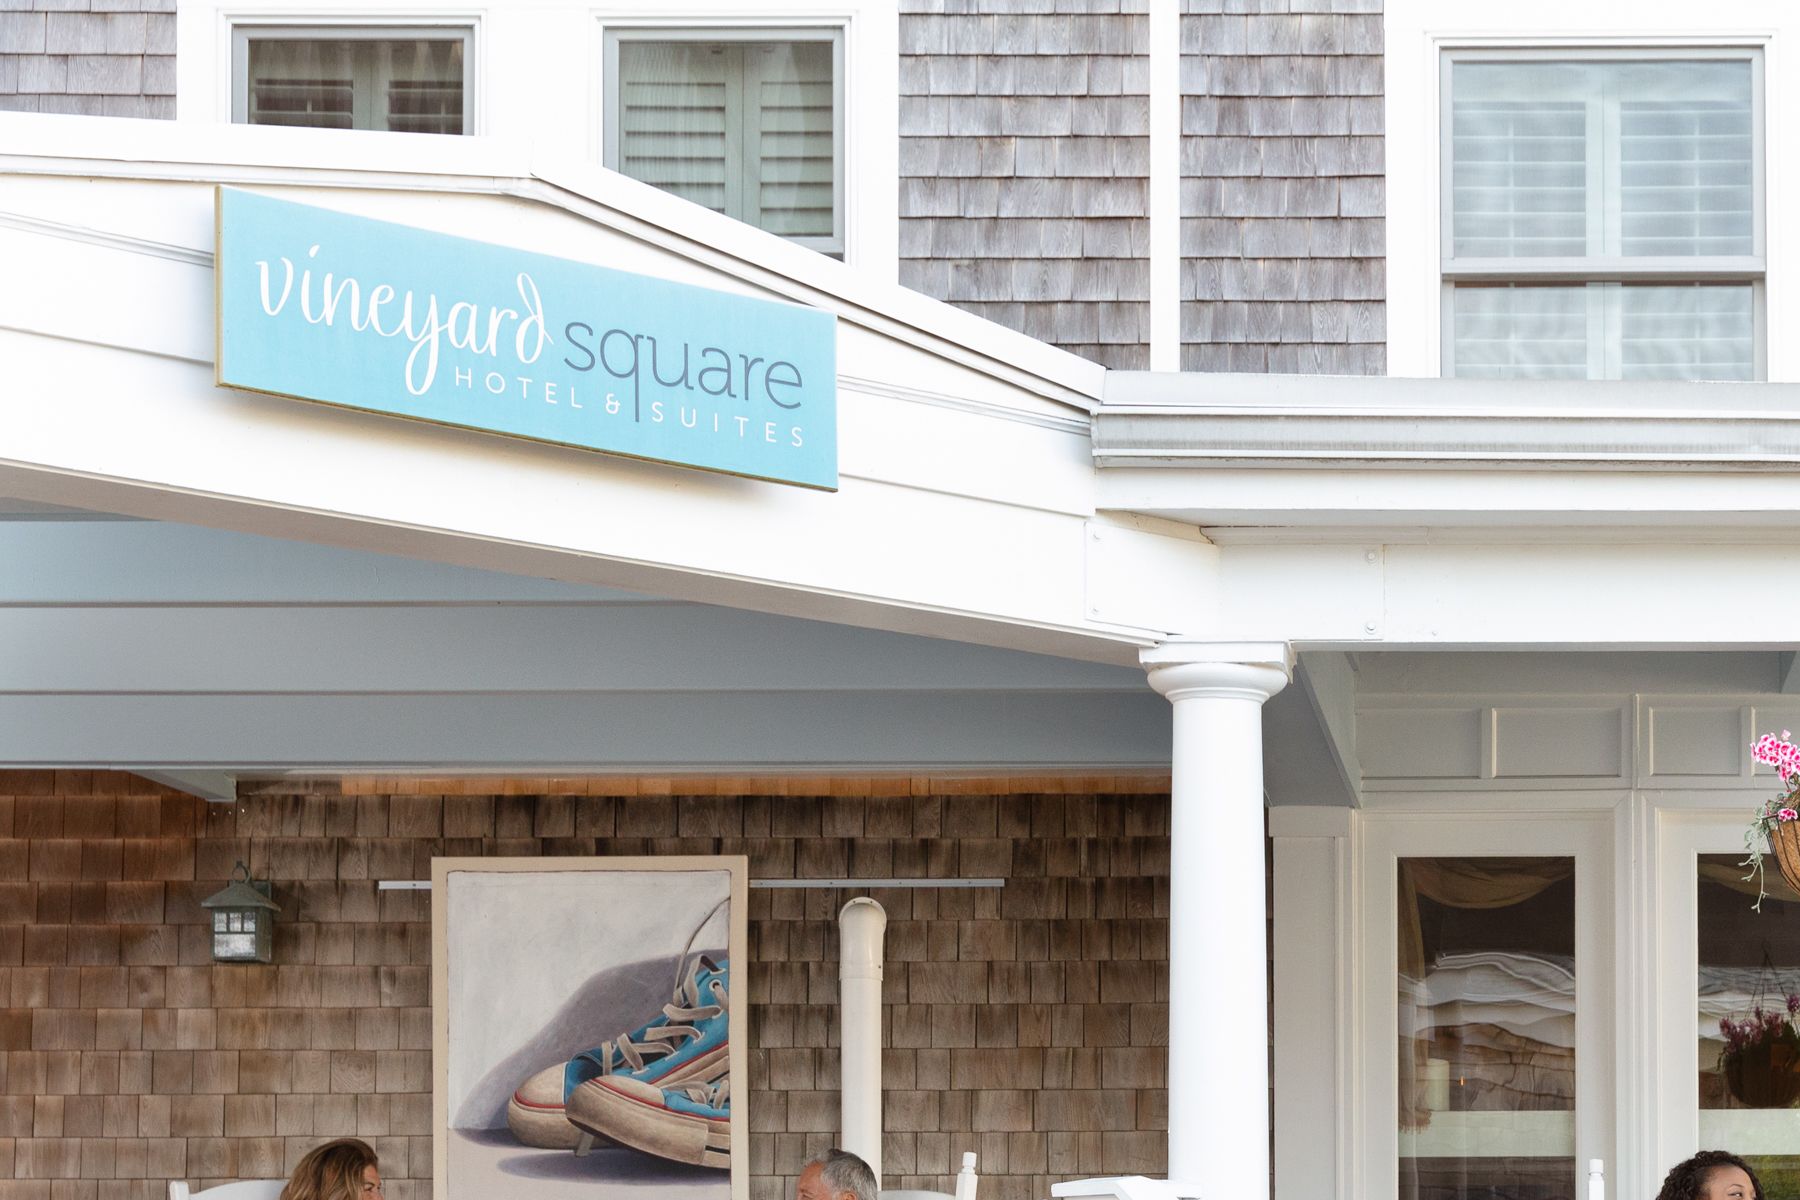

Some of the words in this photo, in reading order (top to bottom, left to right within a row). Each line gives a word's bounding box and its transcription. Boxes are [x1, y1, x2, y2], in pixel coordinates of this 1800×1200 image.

[256, 245, 554, 395] vineyard
[564, 322, 803, 422] square
[455, 367, 584, 409] HOTEL
[606, 394, 621, 415] &
[652, 402, 803, 448] SUITES
